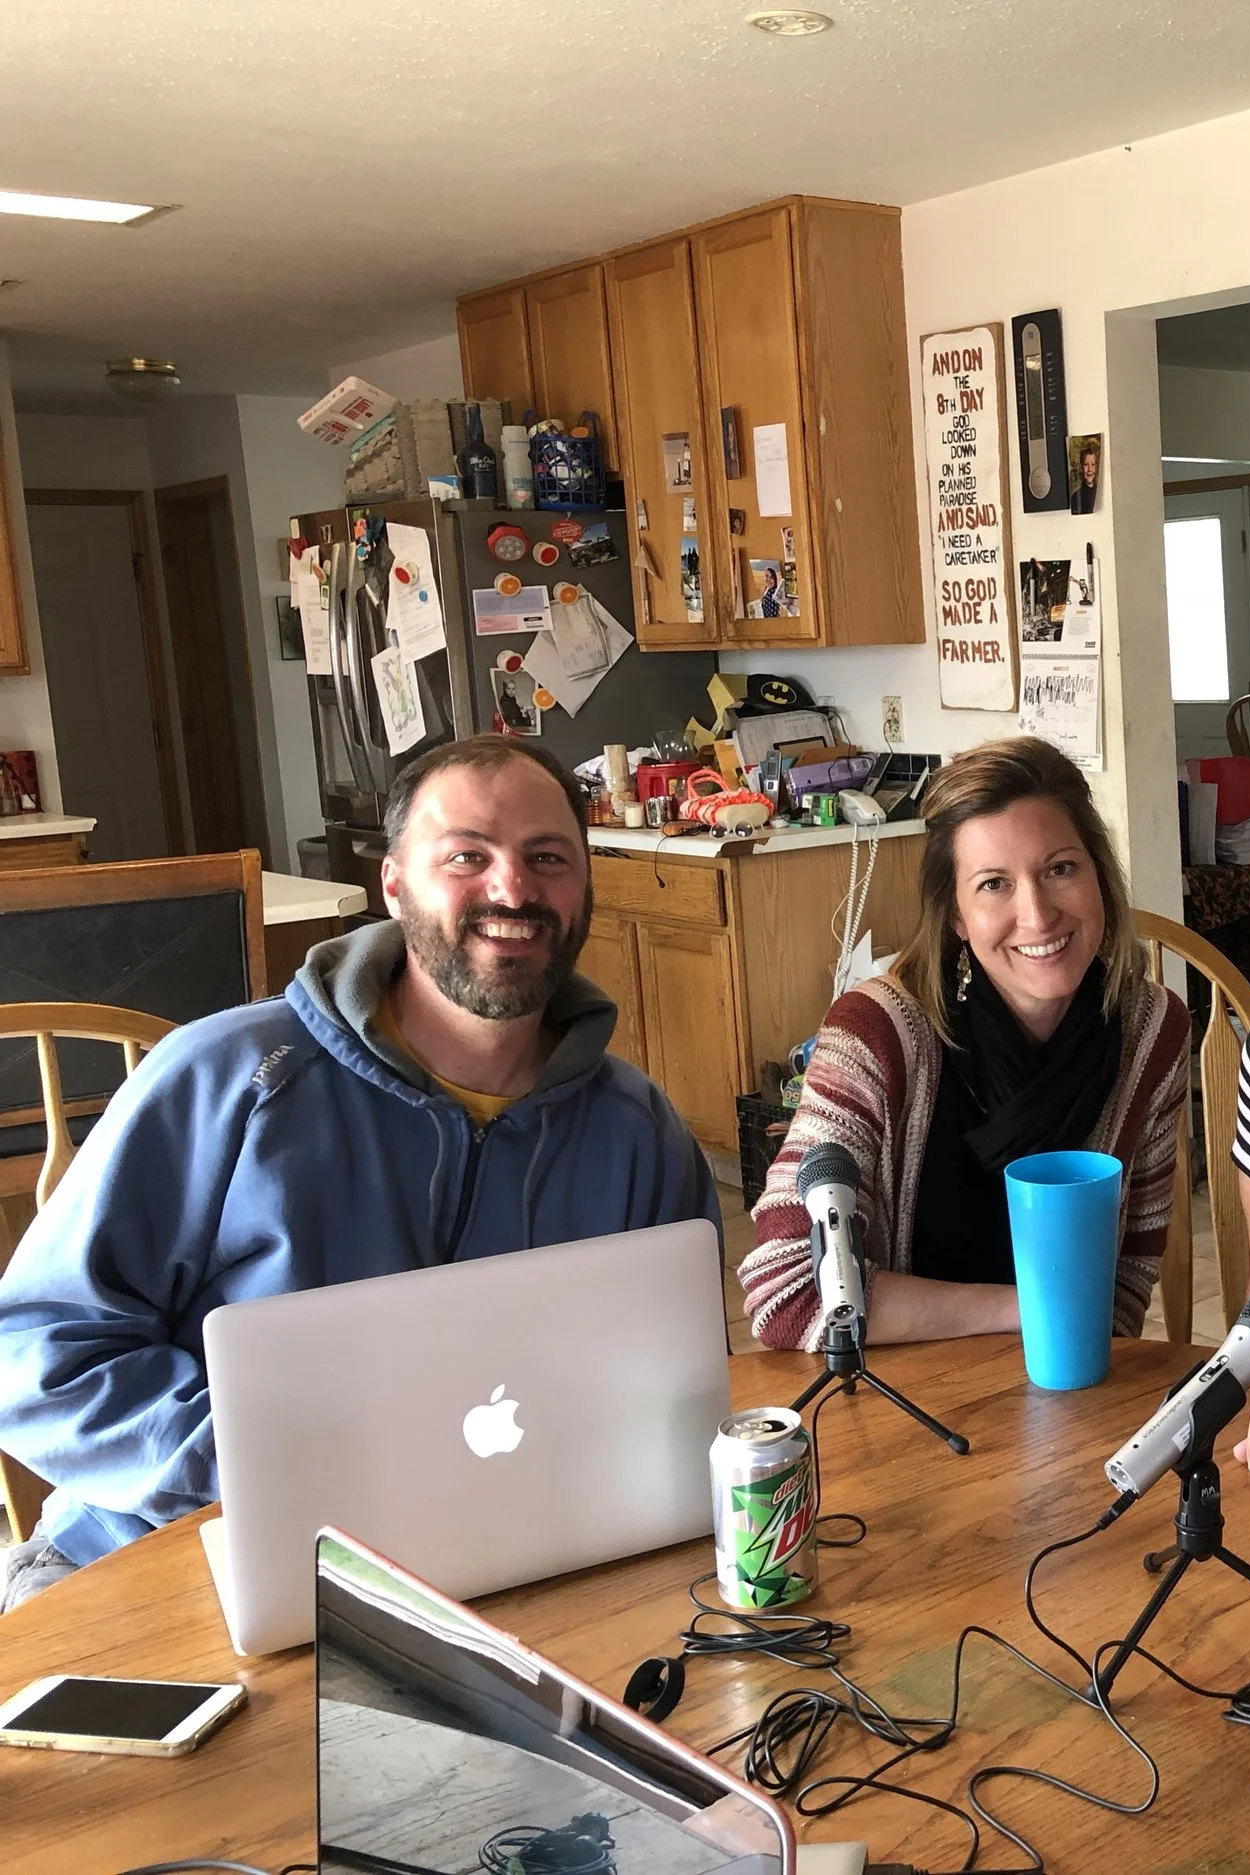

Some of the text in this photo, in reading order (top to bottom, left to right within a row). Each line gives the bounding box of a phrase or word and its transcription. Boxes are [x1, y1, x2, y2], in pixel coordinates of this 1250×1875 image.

[932, 346, 984, 376] AND ON
[953, 375, 970, 390] THE
[936, 387, 984, 415] 8TH DAY
[953, 414, 970, 428] GOD
[942, 427, 976, 445] LOOKED
[950, 445, 977, 459] DOWN
[942, 462, 971, 476] ON HIS
[939, 476, 977, 494] PLANNED
[939, 492, 977, 508] PARADISE
[937, 507, 963, 534] AND
[948, 534, 972, 549] NEED
[976, 533, 982, 547] A
[942, 576, 997, 603] SO GOD
[942, 601, 998, 627] MADE A
[942, 638, 1005, 664] FARMER.
